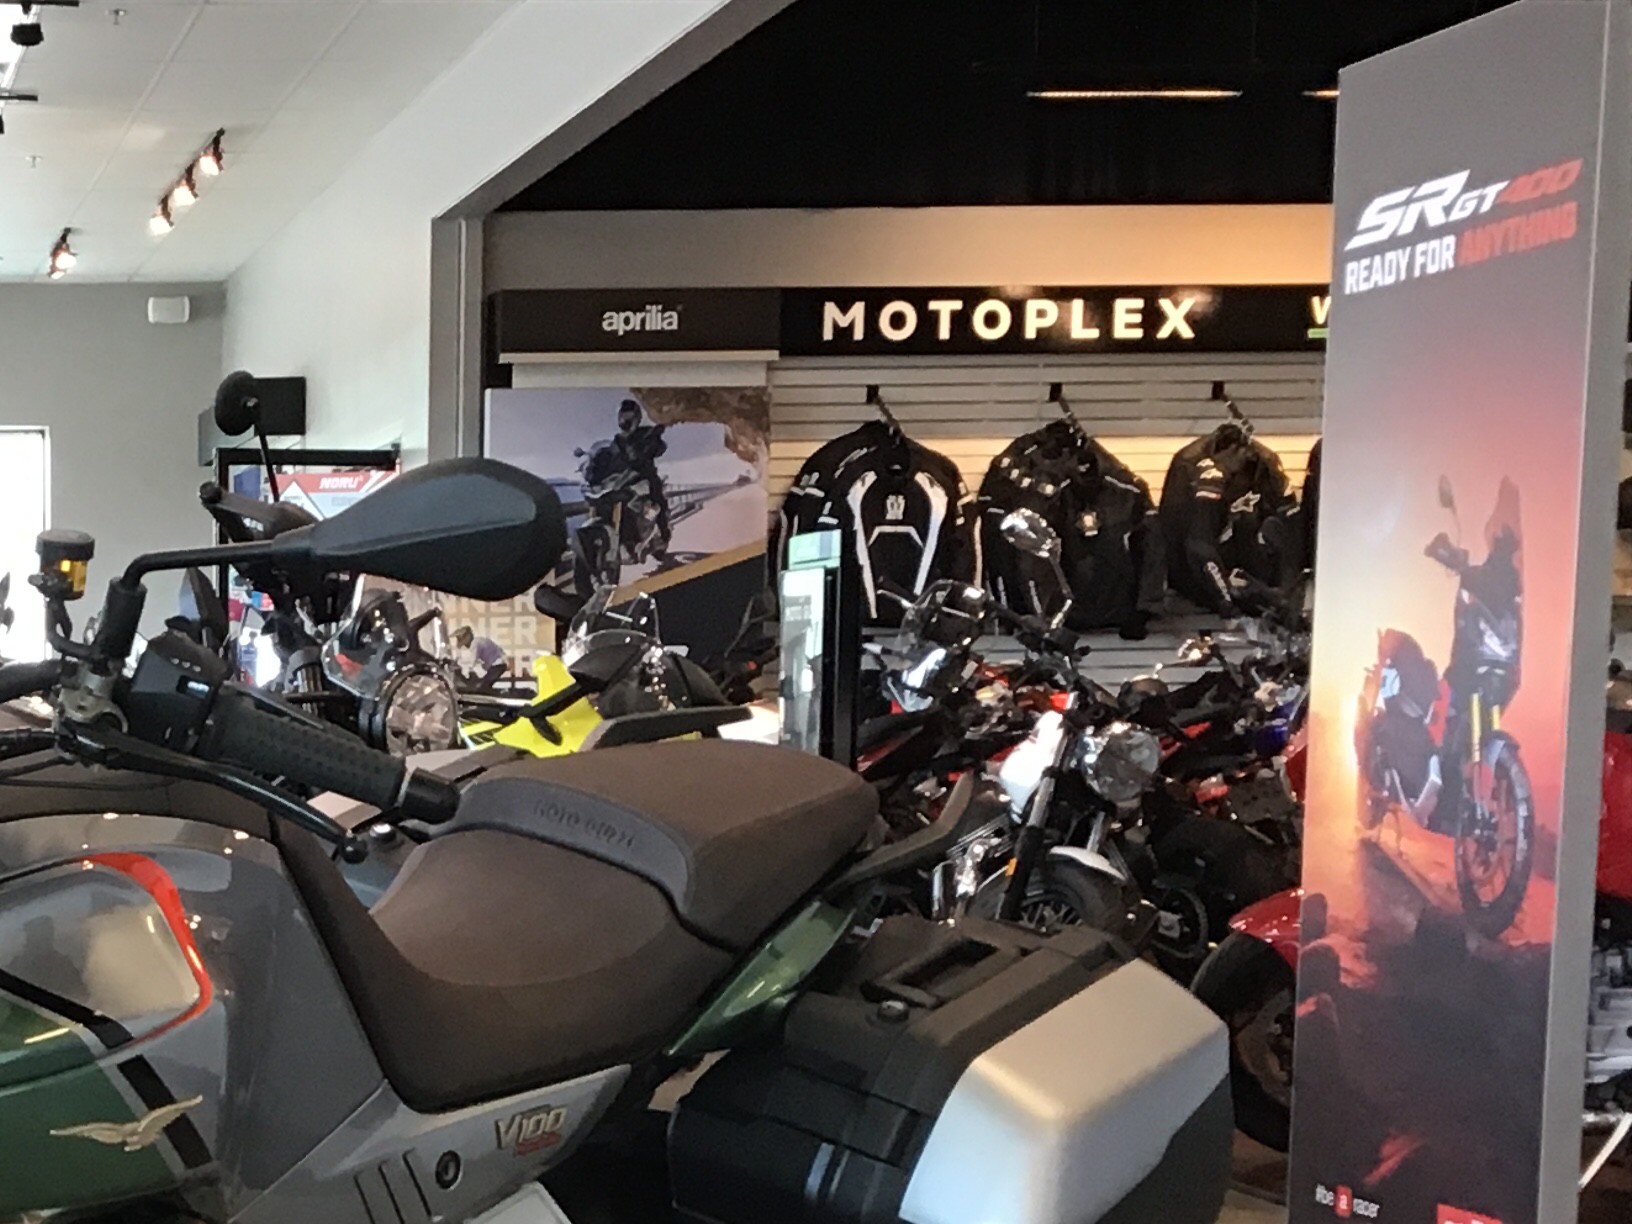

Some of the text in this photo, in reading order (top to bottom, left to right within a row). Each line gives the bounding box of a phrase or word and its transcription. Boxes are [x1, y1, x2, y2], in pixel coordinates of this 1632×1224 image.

[1345, 247, 1411, 295] READY
[1414, 234, 1456, 278] FOR
[601, 304, 679, 336] aprilia
[822, 298, 1197, 341] MOTOPLEX
